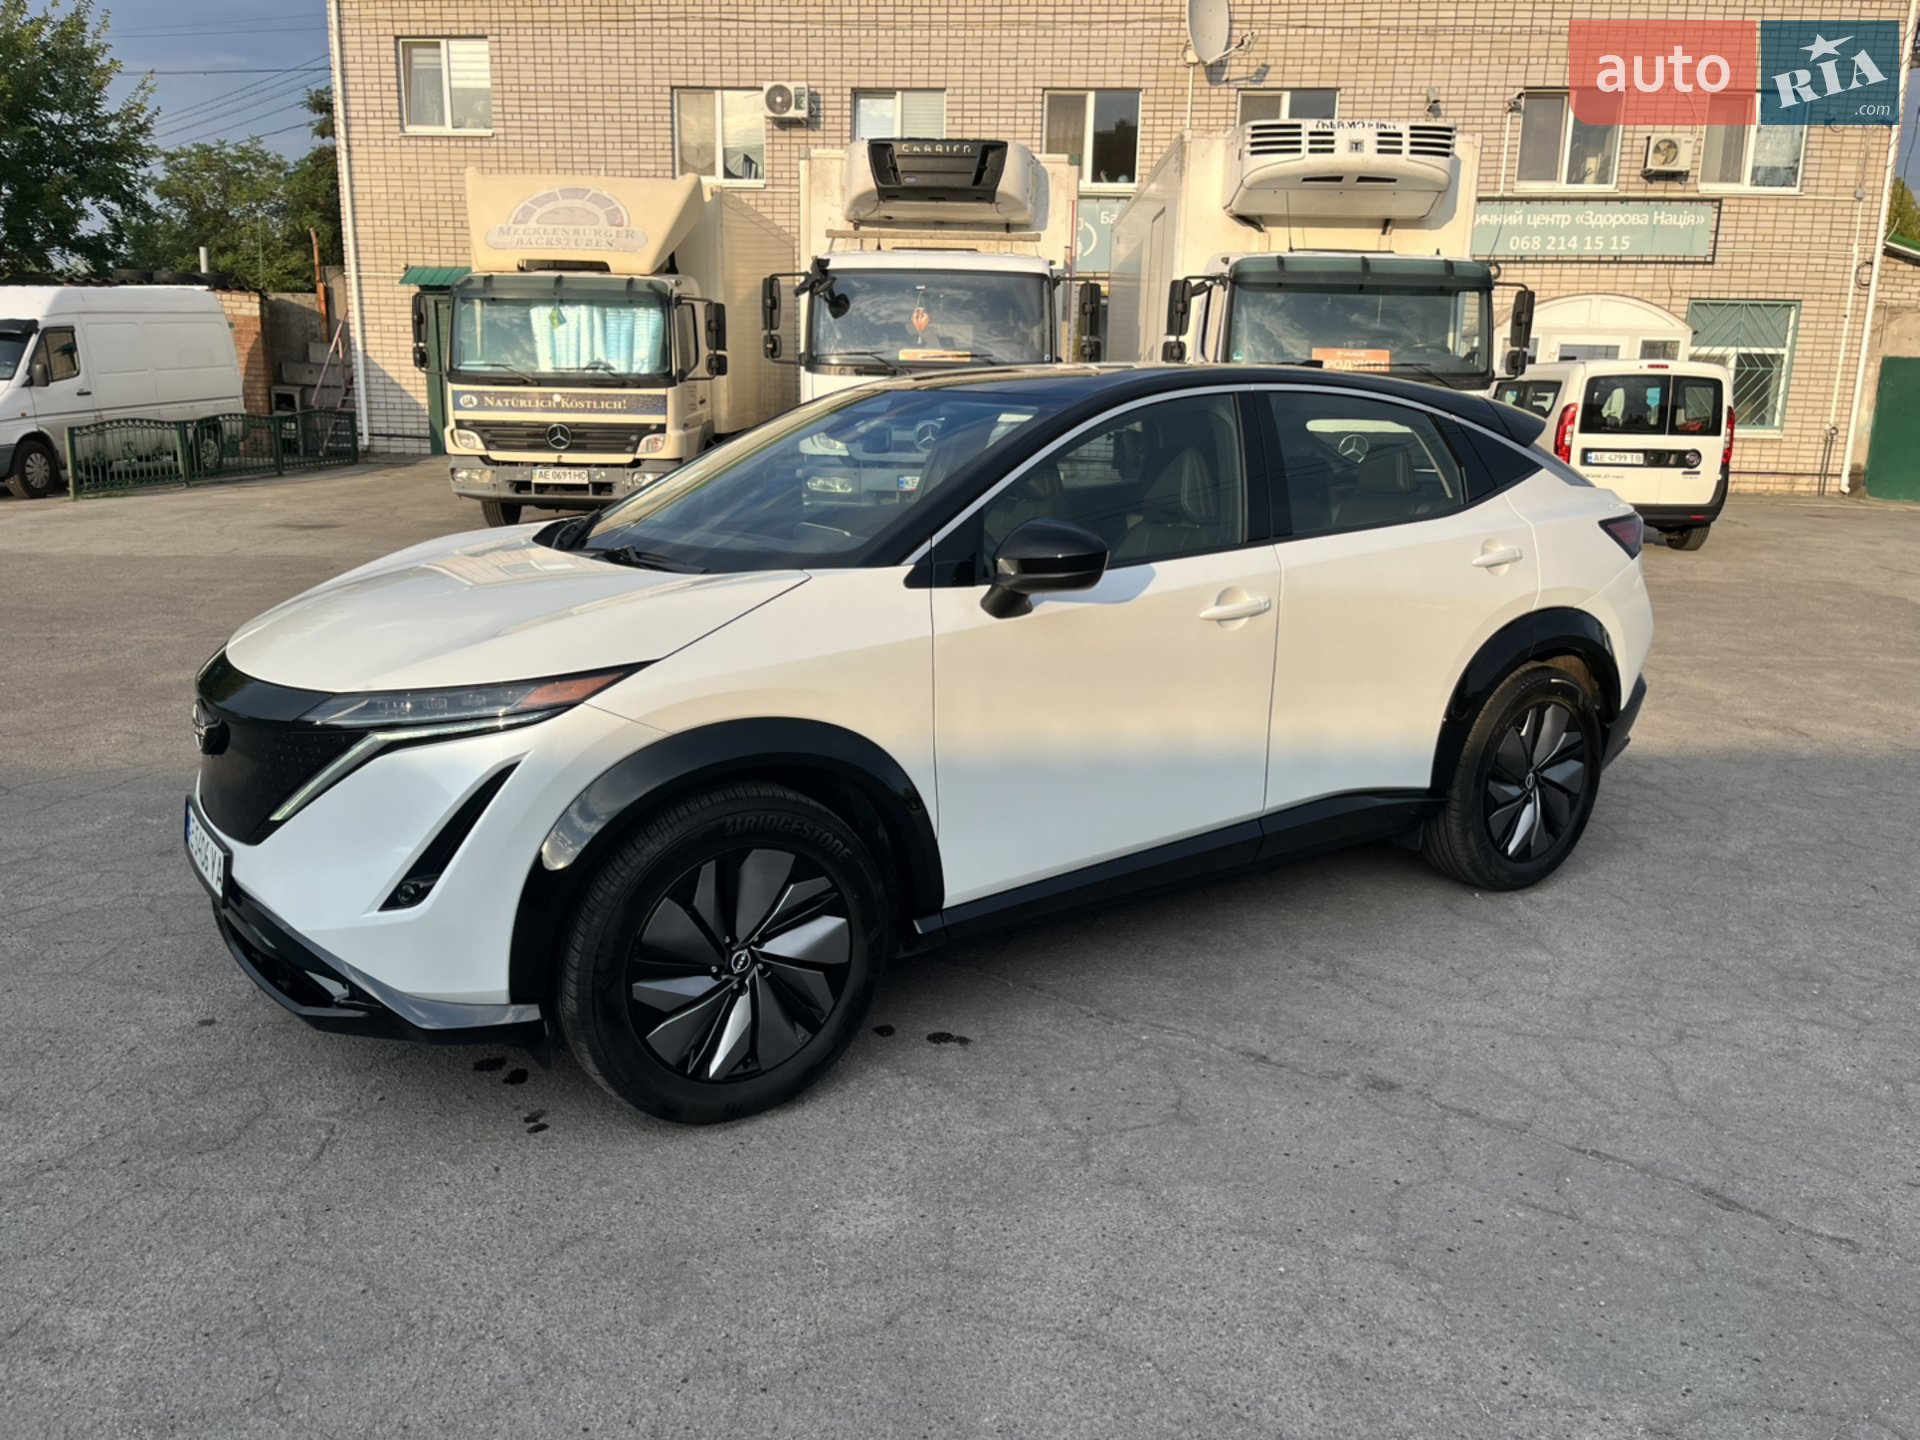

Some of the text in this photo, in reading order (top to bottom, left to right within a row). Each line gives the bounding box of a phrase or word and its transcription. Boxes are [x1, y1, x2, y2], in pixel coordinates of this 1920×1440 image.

[1526, 213, 1572, 229] центр
[1575, 210, 1650, 229] «Здорова
[1652, 210, 1706, 229] Нація»
[498, 226, 636, 240] MECKLENBURGER
[515, 236, 615, 248] BACKSTUBEN
[1509, 235, 1632, 251] 068 214 15 15
[1322, 359, 1386, 371] РОДУКТИ
[462, 396, 474, 406] UA
[1594, 453, 1606, 462] AE
[538, 470, 551, 480] AE
[551, 470, 573, 481] 0691
[724, 814, 853, 863] BRIDGESTONE
